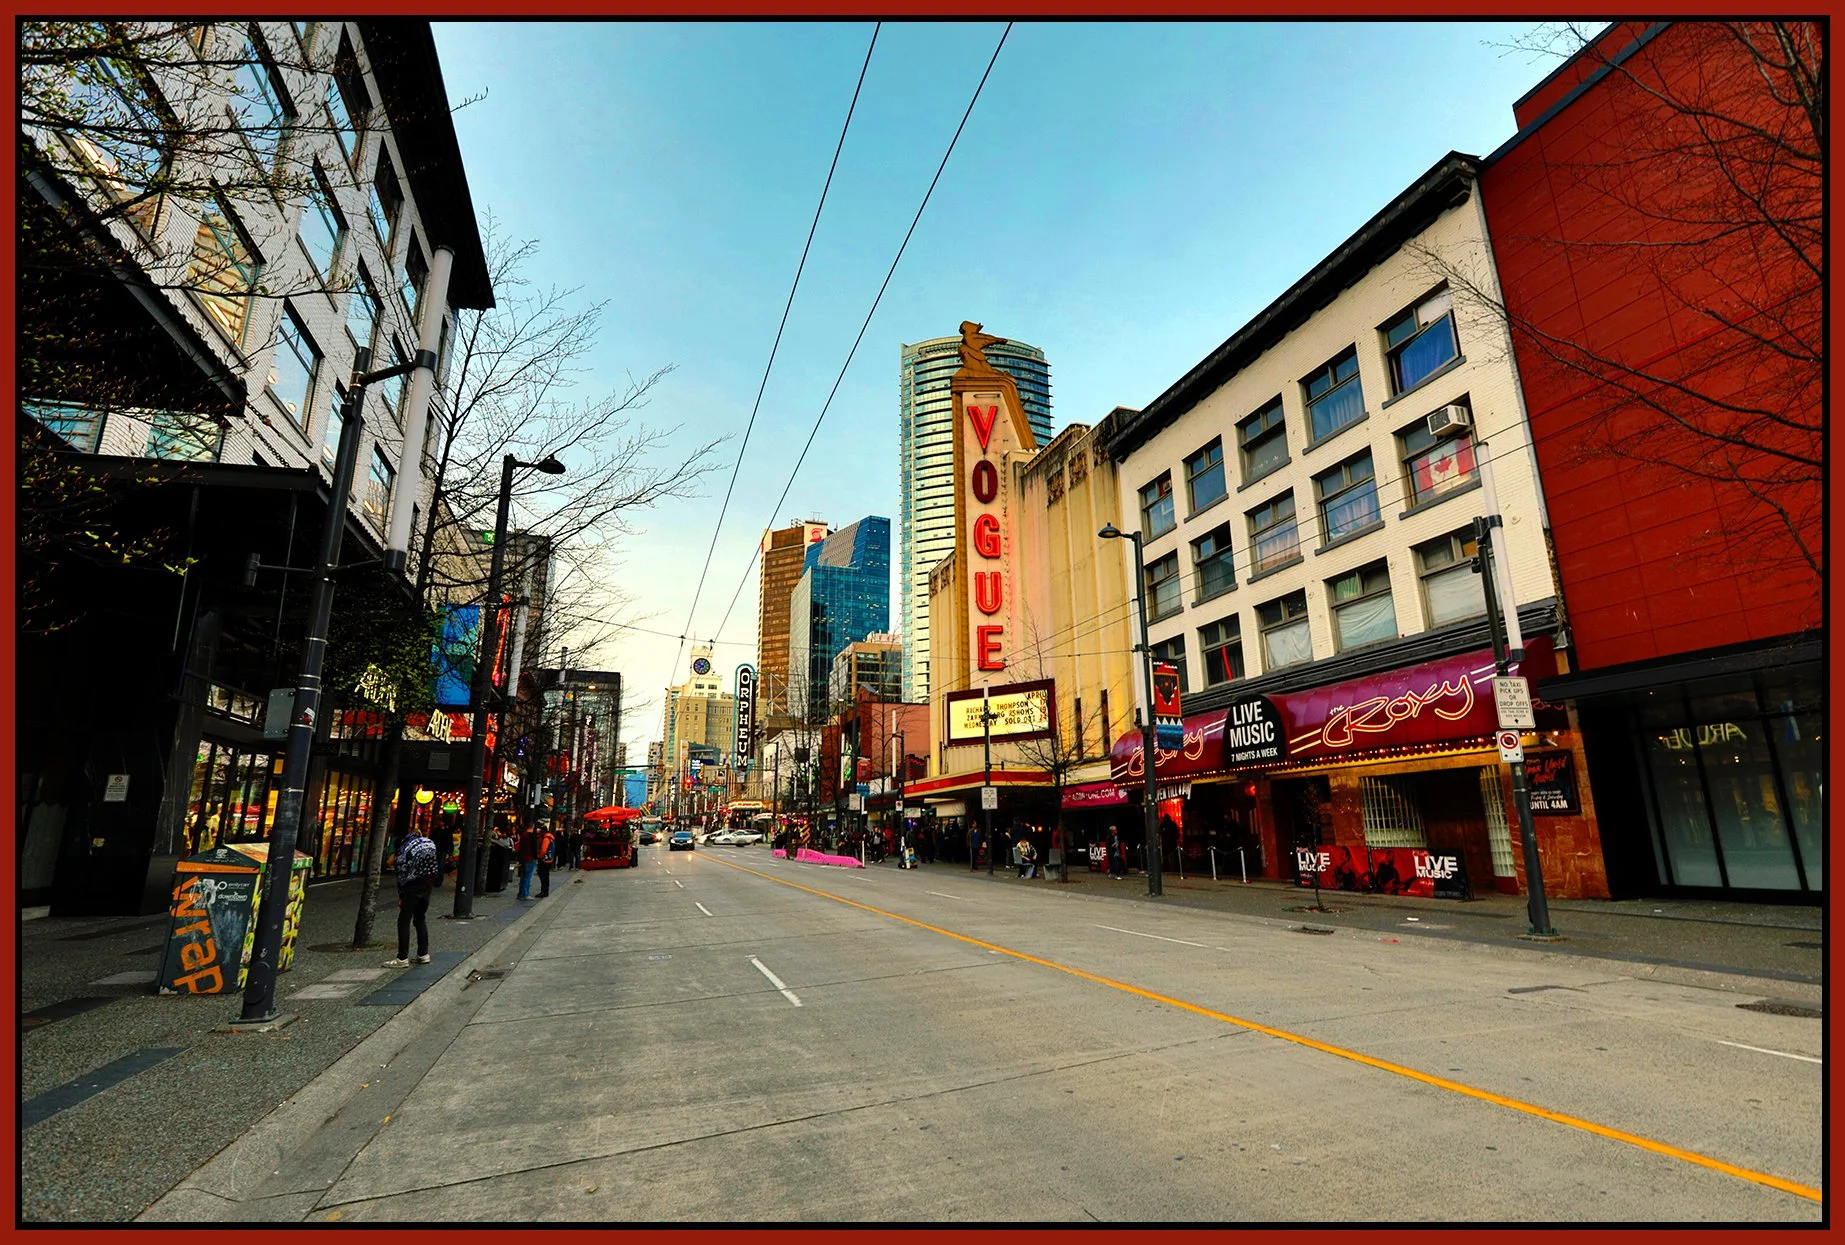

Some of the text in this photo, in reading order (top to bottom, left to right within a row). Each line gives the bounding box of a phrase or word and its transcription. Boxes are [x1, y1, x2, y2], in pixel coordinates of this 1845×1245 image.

[967, 406, 1005, 671] VOGUE
[966, 705, 991, 714] RICHAD
[996, 701, 1028, 710] THOMPSON
[1232, 700, 1263, 726] LIVE
[1322, 674, 1475, 748] the Roxy
[737, 672, 750, 766] ORPHEUM
[964, 718, 997, 729] WEDNESAY
[1004, 716, 1021, 726] SOLD
[1230, 721, 1275, 748] MUSIC
[1231, 747, 1278, 762] 7 NIGHTS A WEEK
[1530, 799, 1568, 810] UNTIL 4AM
[1089, 846, 1107, 857] LIVE
[1297, 852, 1331, 866] LIVE
[1413, 855, 1459, 872] LIVE
[1416, 869, 1453, 880] MUSIC
